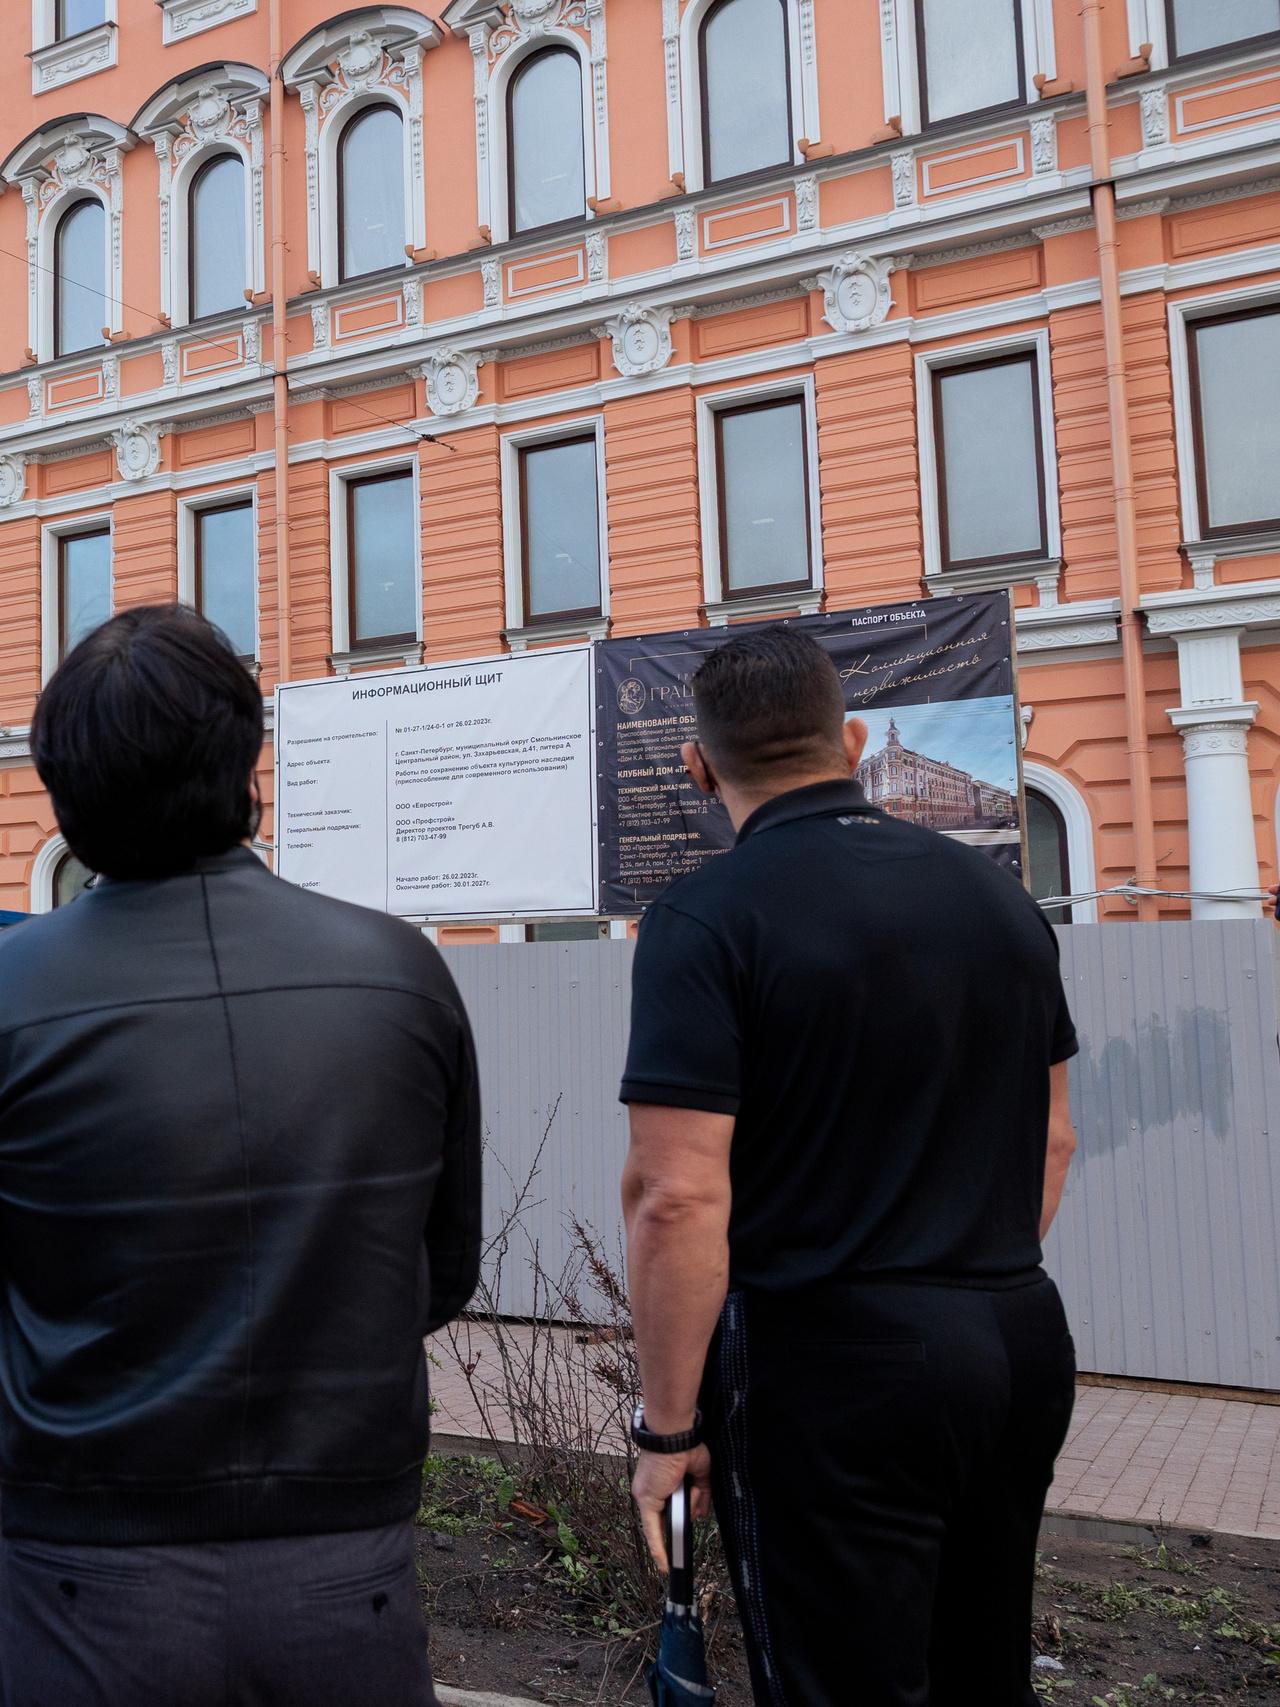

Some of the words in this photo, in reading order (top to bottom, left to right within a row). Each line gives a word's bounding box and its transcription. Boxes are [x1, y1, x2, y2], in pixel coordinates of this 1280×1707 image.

[852, 615, 888, 626] ПАСПОРТ
[890, 610, 926, 621] ОБЪЕКТА
[839, 632, 991, 684] Коллекционная
[853, 653, 981, 704] недвижимость
[352, 676, 471, 700] ИНФОРМАЦИОННЫЙ
[475, 672, 503, 687] ЩИТ
[651, 684, 695, 700] ГРАЦ
[456, 718, 492, 727] 26.02.2023г.
[617, 717, 677, 730] НАИМЕНОВАНИЕ
[287, 736, 322, 746] Разрешение
[332, 731, 378, 741] строительство:
[617, 729, 663, 739] Приспособление
[401, 746, 454, 757] Санкт-Петербург,
[456, 740, 509, 751] муниципальный
[531, 733, 581, 743] Смольнинское
[617, 738, 659, 746] использования
[395, 756, 438, 765] Центральный
[474, 747, 520, 758] Захарьевская,
[540, 743, 564, 751] литера
[618, 746, 643, 754] наследия
[645, 744, 682, 753] регионально
[618, 755, 632, 763] «Дом
[645, 752, 677, 761] Шрейбера»
[287, 760, 304, 768] Адрес
[306, 758, 331, 766] объекта:
[430, 765, 469, 774] сохранению
[471, 761, 497, 770] объекта
[499, 758, 539, 768] культурного
[395, 775, 450, 785] (приспособление
[465, 769, 511, 779] современного
[513, 764, 568, 774] использования)
[618, 767, 654, 778] КЛУБНЫЙ
[656, 766, 673, 776] ДОМ
[676, 765, 688, 773] «ТР
[618, 784, 658, 794] ТЕХНИЧЕСКИЙ
[660, 783, 692, 791] ЗАКАЗЧИК:
[631, 793, 666, 801] «Еврострой»
[412, 800, 452, 809] «Еврострой»
[618, 803, 667, 811] Санкт-Петербург,
[287, 810, 322, 818] Технический
[618, 811, 651, 819] Контактное
[412, 816, 455, 825] «Профстрой»
[641, 818, 670, 826] 703-47-99
[287, 825, 325, 834] Генеральный
[327, 823, 361, 831] подрядчик:
[396, 826, 425, 835] Директор
[427, 825, 456, 833] проектов
[418, 833, 446, 841] 703-47-99
[619, 834, 661, 843] ГЕНЕРАЛЬНЫЙ
[287, 842, 313, 850] Телефон:
[632, 843, 670, 851] «Профстрой»
[620, 852, 669, 860] Санкт-Петербург,
[620, 868, 652, 876] Контактное
[671, 866, 690, 875] Трегуб
[420, 874, 440, 882] работ:
[442, 872, 478, 880] 26.02.2023г.
[454, 880, 490, 888] 30.01.2027г.
